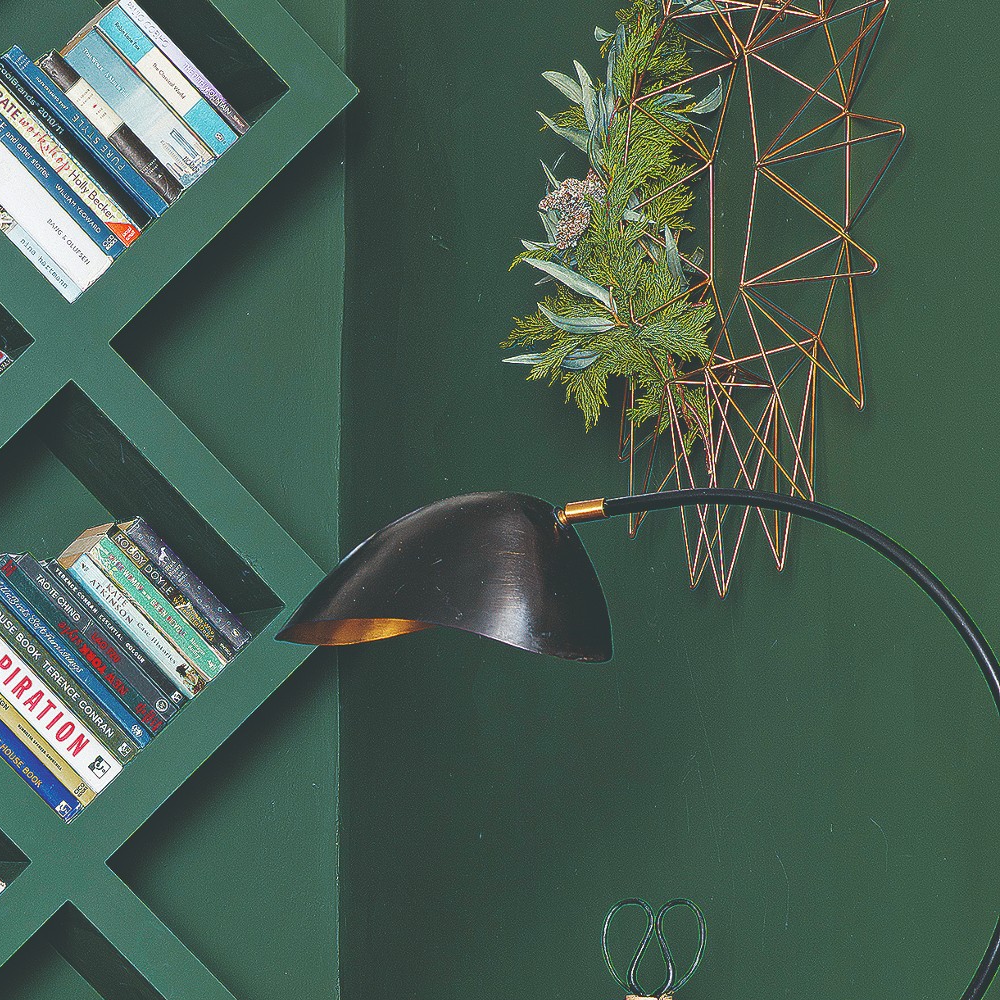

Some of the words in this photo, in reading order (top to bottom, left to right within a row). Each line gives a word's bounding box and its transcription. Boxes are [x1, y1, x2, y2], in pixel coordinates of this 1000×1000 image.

[158, 69, 176, 88] Classical
[172, 85, 187, 100] World
[37, 106, 65, 135] 2010/11
[71, 113, 101, 145] STYLE
[17, 115, 77, 176] workshop
[99, 144, 126, 171] PURE
[54, 183, 77, 207] WILLIAM
[75, 205, 102, 234] YEOWARD
[66, 169, 91, 195] Holly
[86, 189, 117, 223] Becker
[37, 255, 69, 289] hartmann
[35, 573, 51, 590] TAO
[46, 585, 60, 600] TE
[57, 596, 81, 622] CHING
[89, 578, 134, 624] ATKINSON
[105, 582, 129, 608] KATE
[15, 631, 43, 660] BOOK
[136, 621, 151, 638] Case
[150, 636, 177, 664] Histories
[41, 659, 80, 702] TERENCE
[78, 698, 115, 738] CONRAN
[0, 743, 24, 769] HOUSE
[21, 766, 43, 788] BOOK
